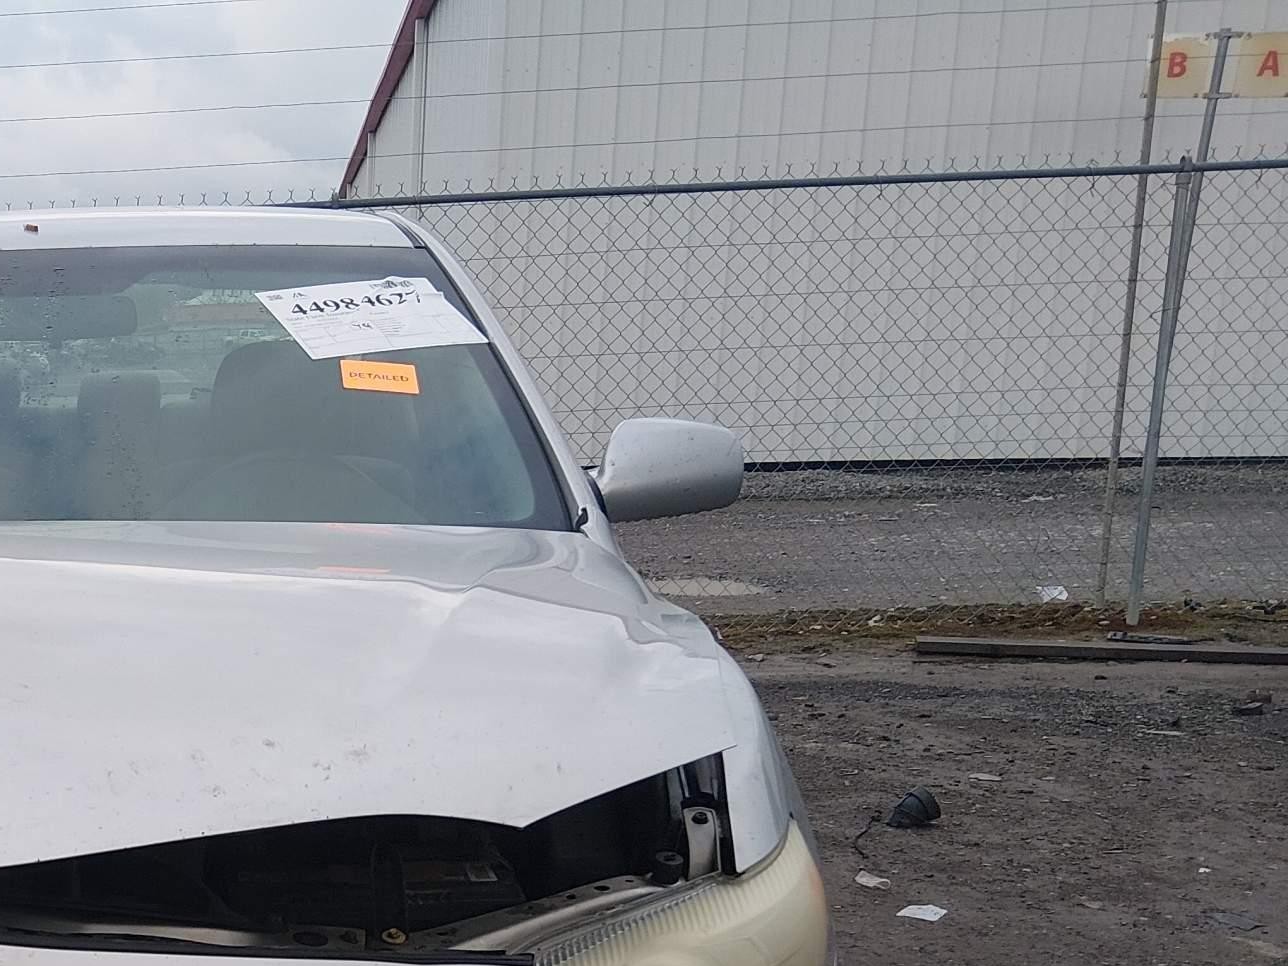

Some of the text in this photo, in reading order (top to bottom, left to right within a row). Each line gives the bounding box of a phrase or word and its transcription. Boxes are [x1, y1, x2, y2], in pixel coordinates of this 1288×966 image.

[1167, 52, 1188, 78] B
[1256, 50, 1280, 77] A
[291, 290, 422, 316] 44984627
[349, 371, 409, 383] DETAILED
